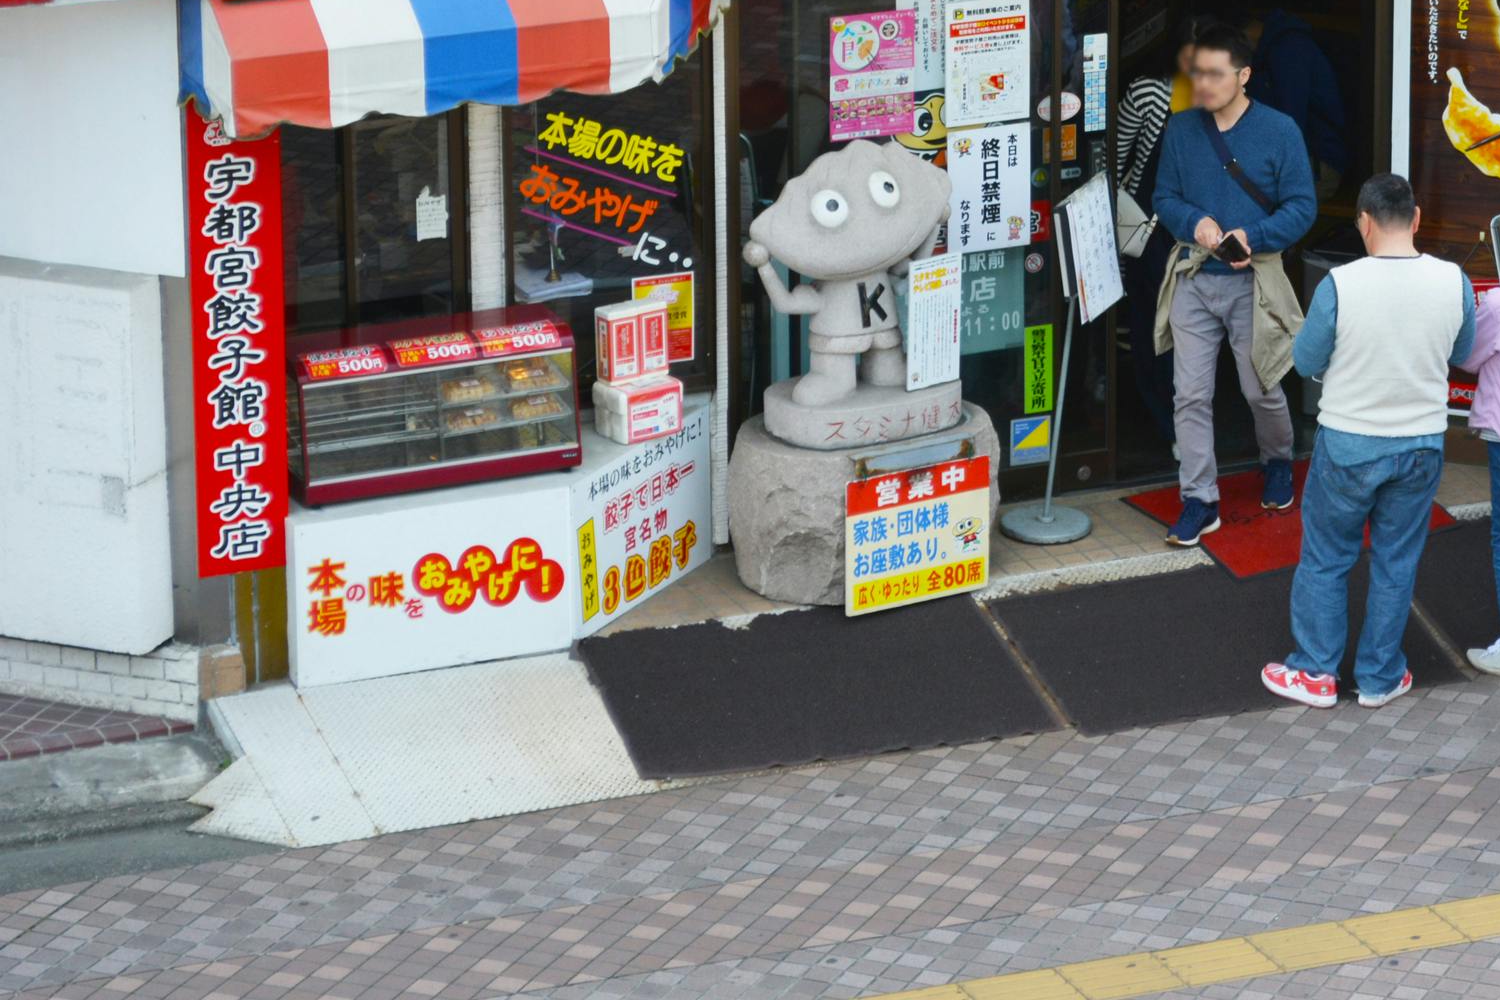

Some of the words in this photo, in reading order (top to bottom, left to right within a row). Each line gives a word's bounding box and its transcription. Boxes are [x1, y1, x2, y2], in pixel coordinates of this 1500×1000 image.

[538, 112, 685, 183] 本場の味を
[1007, 133, 1018, 168] 本日は
[520, 164, 659, 233] おみやげ
[959, 200, 971, 247] なります
[202, 155, 262, 425] 宇都宮餃子館
[858, 281, 887, 329] K
[427, 344, 472, 360] 500円
[512, 332, 556, 348] 500円
[338, 357, 383, 374] 500円
[1031, 328, 1046, 409] 警察官立寄所
[825, 401, 961, 441] スタミナ健太
[211, 441, 268, 561] 中央店
[603, 460, 696, 534] 餃子で日本一
[875, 466, 965, 507] 営業中
[624, 507, 668, 553] 宮名物
[853, 502, 949, 545] 家族・団体様
[581, 532, 596, 611] おみやげ
[602, 520, 697, 615] 3色餃子
[853, 538, 947, 578] お座敷あり。
[927, 561, 982, 592] 全80席
